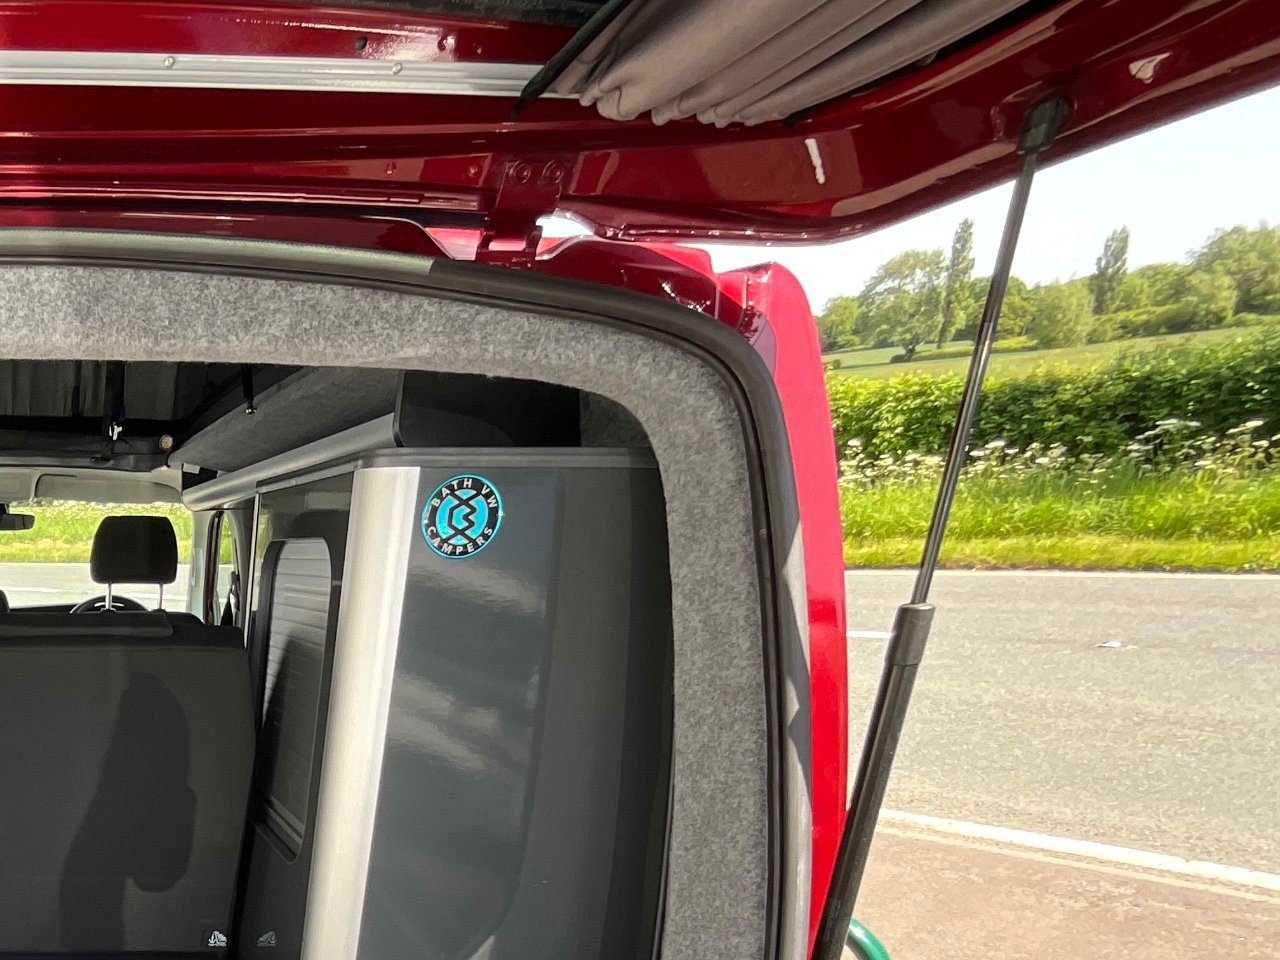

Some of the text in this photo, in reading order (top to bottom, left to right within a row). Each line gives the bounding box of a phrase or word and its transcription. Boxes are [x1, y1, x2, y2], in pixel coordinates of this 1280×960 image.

[431, 478, 498, 508] BATH VW
[427, 526, 493, 555] CAMPERS
